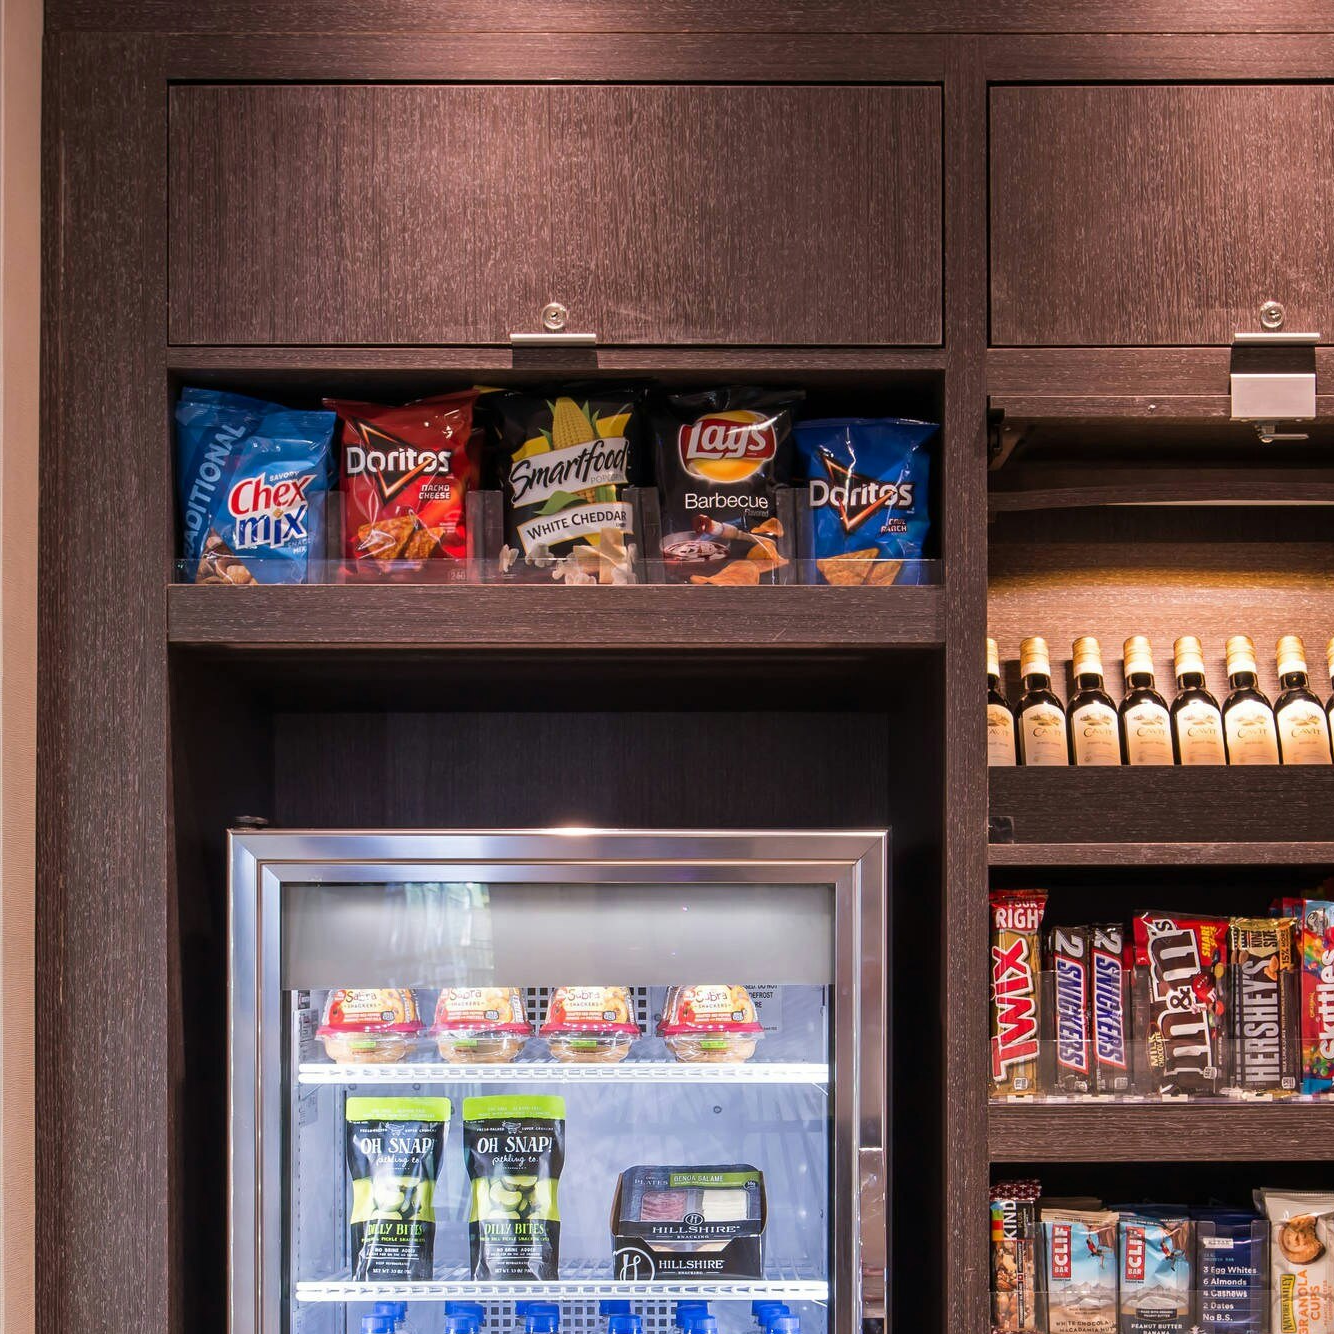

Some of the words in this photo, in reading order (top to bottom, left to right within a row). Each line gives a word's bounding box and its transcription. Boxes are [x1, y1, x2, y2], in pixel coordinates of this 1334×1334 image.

[346, 447, 452, 474] Doritos
[269, 471, 300, 482] SAVORY
[509, 440, 630, 503] Smartfood
[229, 473, 316, 516] Chex
[418, 491, 451, 500] CHEESE
[420, 484, 450, 492] NACHO
[809, 480, 914, 507] Doritos
[685, 493, 769, 509] Barbecue
[526, 515, 569, 540] WHITE
[571, 511, 627, 528] CHEDDAR
[881, 525, 907, 533] RANCH
[996, 908, 1044, 929] RIGHT
[1201, 925, 1210, 957] SHARE
[695, 989, 728, 1003] Sabra
[991, 937, 1041, 1082] TWIX
[1057, 960, 1085, 1069] SNICKERS
[1095, 955, 1125, 1064] SNICKERS
[1150, 1034, 1160, 1067] MILK
[360, 1138, 381, 1154] OH
[387, 1138, 435, 1154] SNAP!
[477, 1137, 499, 1153] OH
[505, 1136, 553, 1153] SNAP!
[367, 1224, 392, 1235] DILLY
[396, 1223, 423, 1235] BITES
[485, 1224, 511, 1235] DILLY
[515, 1223, 545, 1235] BITES
[652, 1225, 737, 1234] HILLSHIRE
[1003, 1200, 1017, 1241] KIND
[1054, 1228, 1069, 1265] CLIF
[1128, 1229, 1144, 1268] CLIF
[659, 1259, 724, 1269] HILLSHIRE
[1203, 1266, 1209, 1274] 3
[1211, 1266, 1225, 1276] Egg
[1228, 1265, 1257, 1275] Whites
[1203, 1278, 1209, 1286] 6
[1211, 1277, 1247, 1286] Almonds
[1282, 1276, 1295, 1302] VALLEY
[1203, 1290, 1209, 1298] 4
[1211, 1289, 1248, 1298] Cashews
[1310, 1285, 1321, 1321] CUPS
[1203, 1302, 1209, 1310] 2
[1211, 1301, 1234, 1310] Dates
[1203, 1313, 1214, 1321] No
[1216, 1313, 1233, 1321] B.S.
[1282, 1302, 1295, 1334] NATURE
